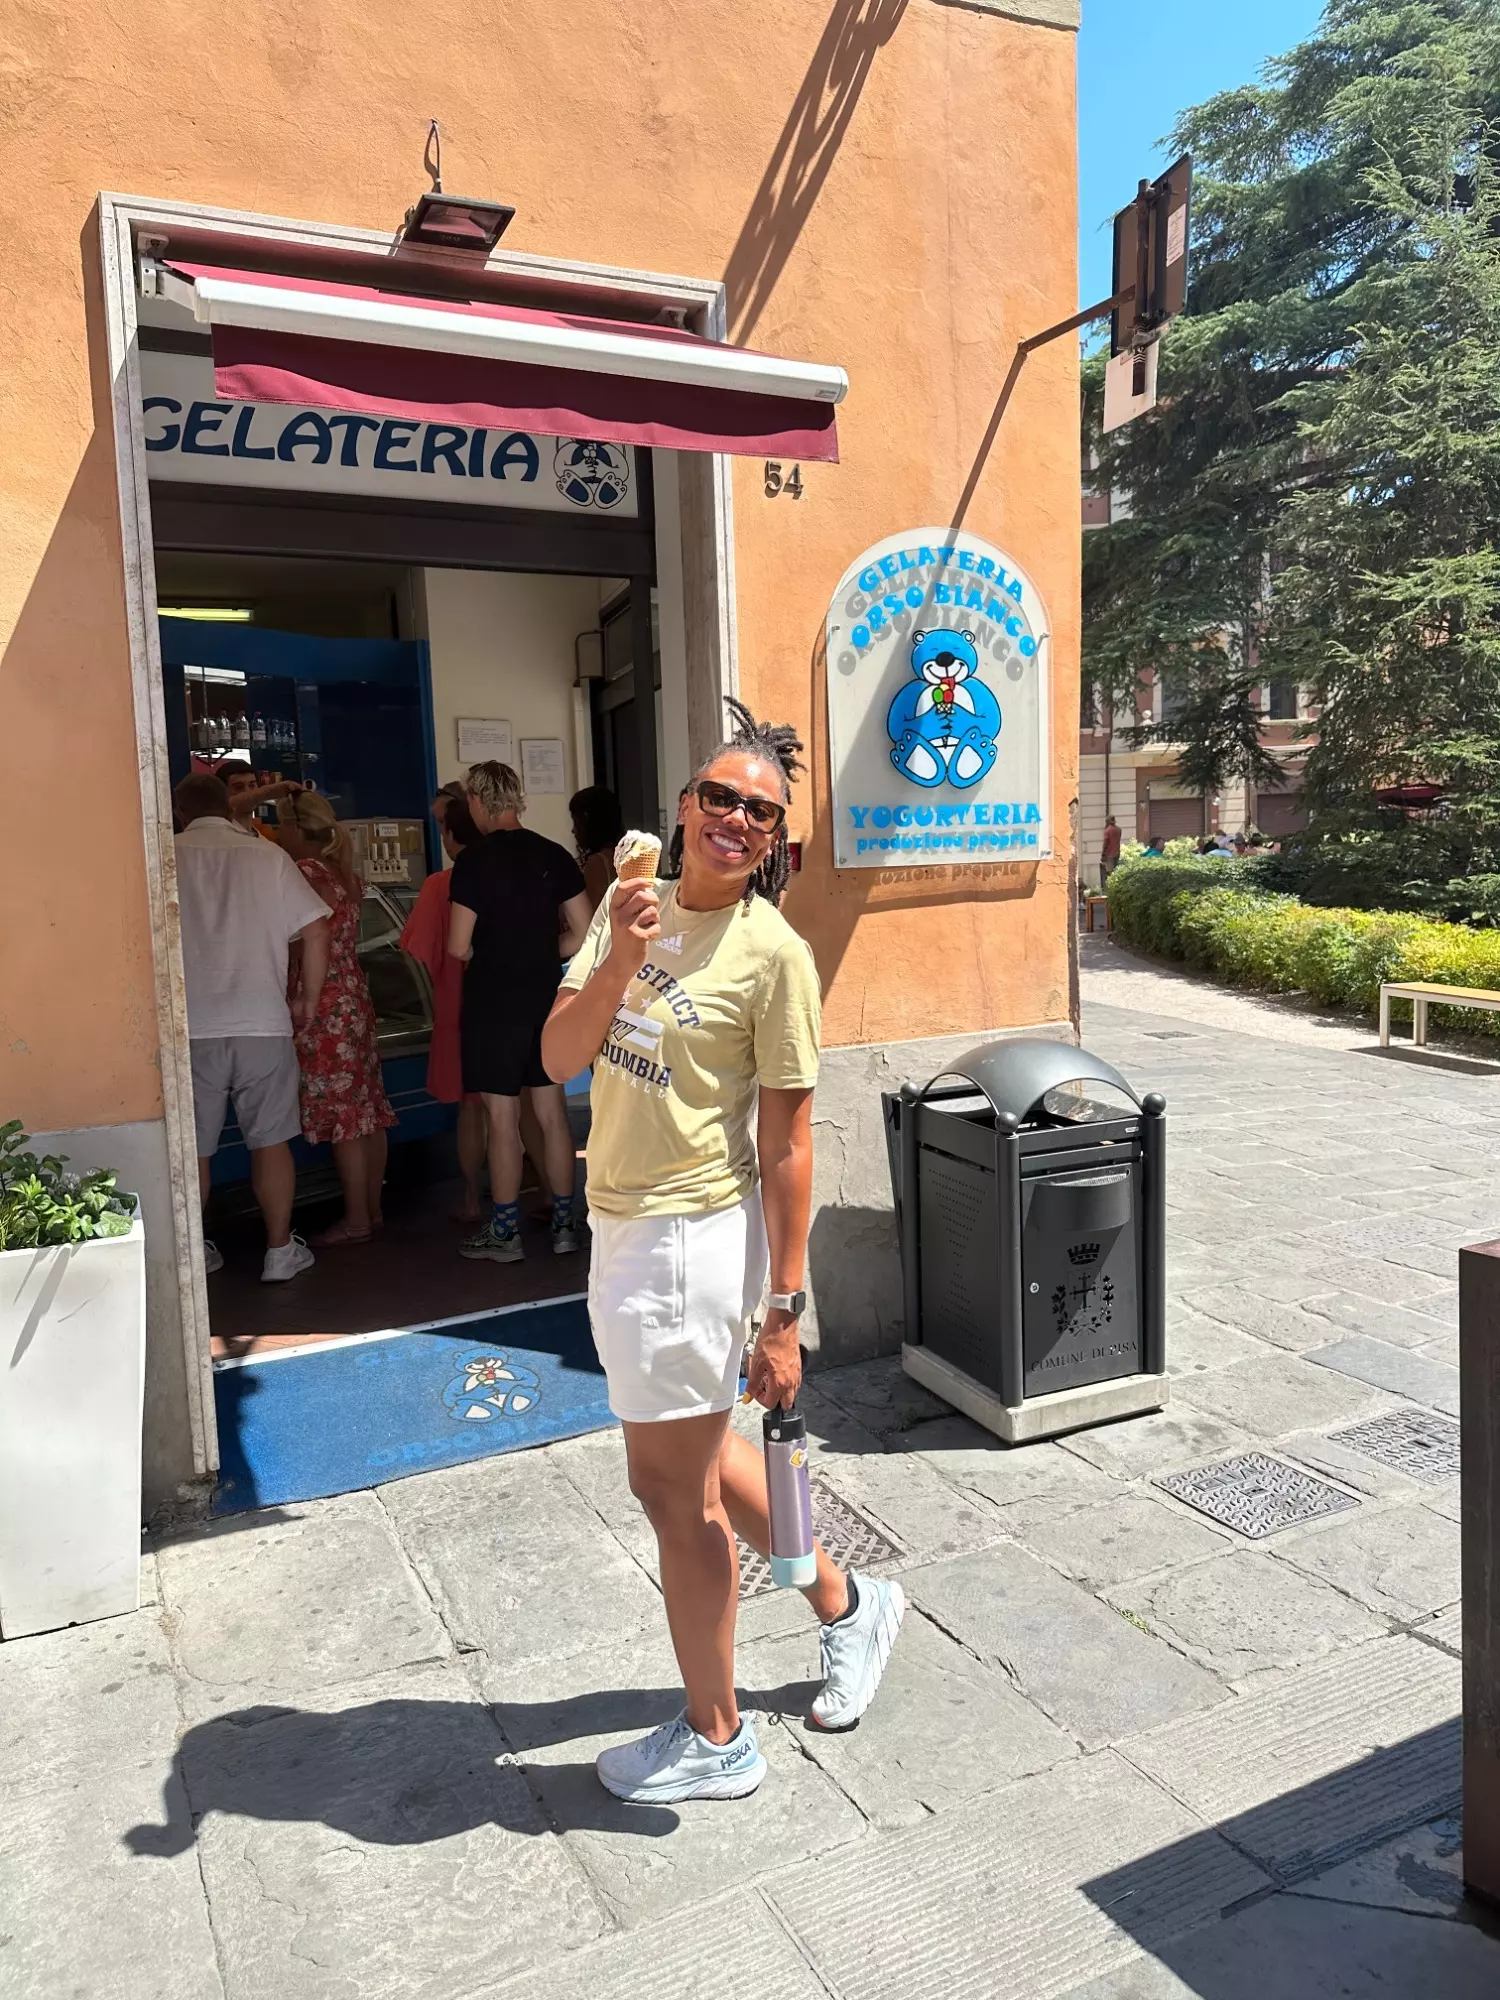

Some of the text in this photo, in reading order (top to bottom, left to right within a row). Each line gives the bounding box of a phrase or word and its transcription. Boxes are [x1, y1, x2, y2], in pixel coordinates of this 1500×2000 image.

[144, 397, 539, 483] GELATERIA
[765, 460, 804, 499] 54
[858, 546, 1025, 603] GELATERIA
[852, 582, 1036, 657] ORSO BIANCO
[848, 803, 1044, 829] YOGURTERIA
[856, 830, 1038, 855] produzione propria
[636, 963, 701, 1029] STRICT
[1031, 1341, 1137, 1372] COMUNE DI PISA
[720, 1742, 752, 1770] HOKA
